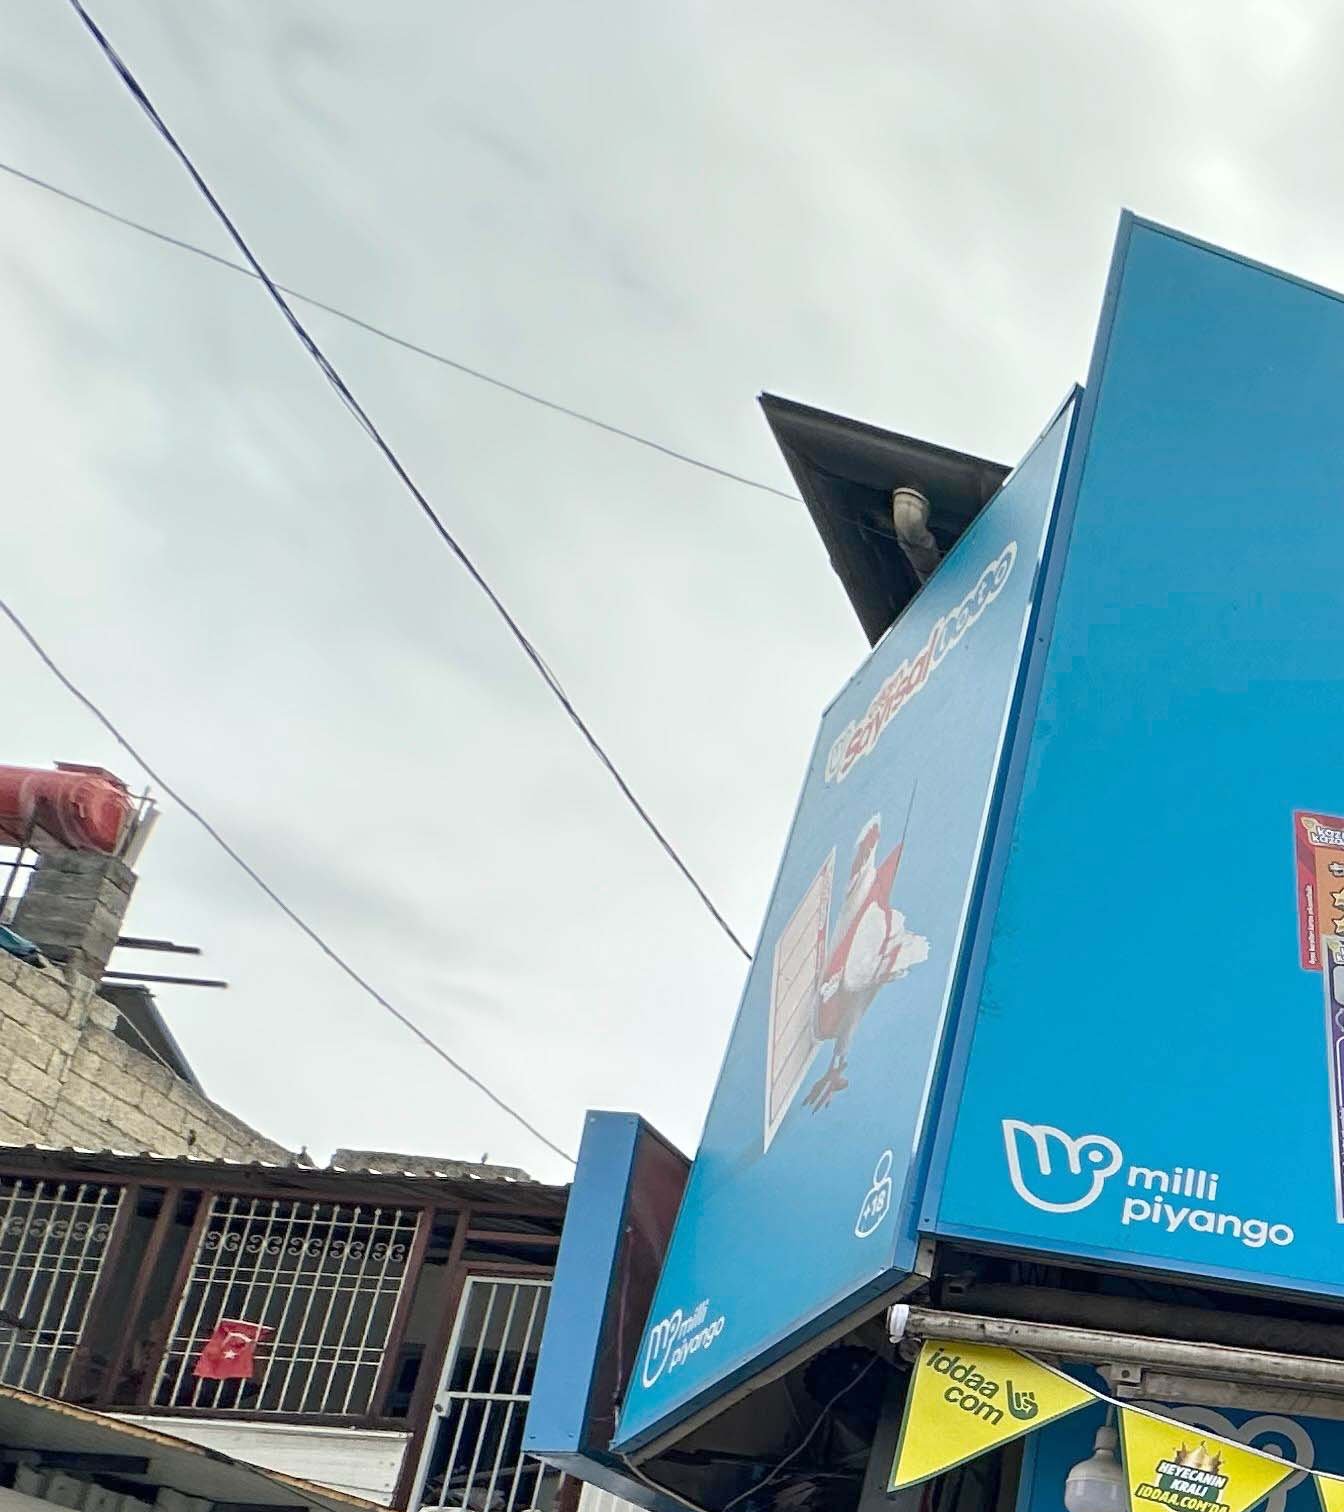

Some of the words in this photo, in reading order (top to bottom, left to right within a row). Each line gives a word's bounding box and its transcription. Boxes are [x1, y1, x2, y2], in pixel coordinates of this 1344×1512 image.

[1127, 1165, 1219, 1201] milli
[863, 1190, 886, 1220] +18
[1122, 1195, 1294, 1248] piyango
[668, 1316, 725, 1374] piyango
[924, 1347, 1001, 1398] iddaa
[943, 1384, 1006, 1427] com
[1155, 1460, 1226, 1489] HEYECANIN
[1169, 1477, 1208, 1498] KRALI
